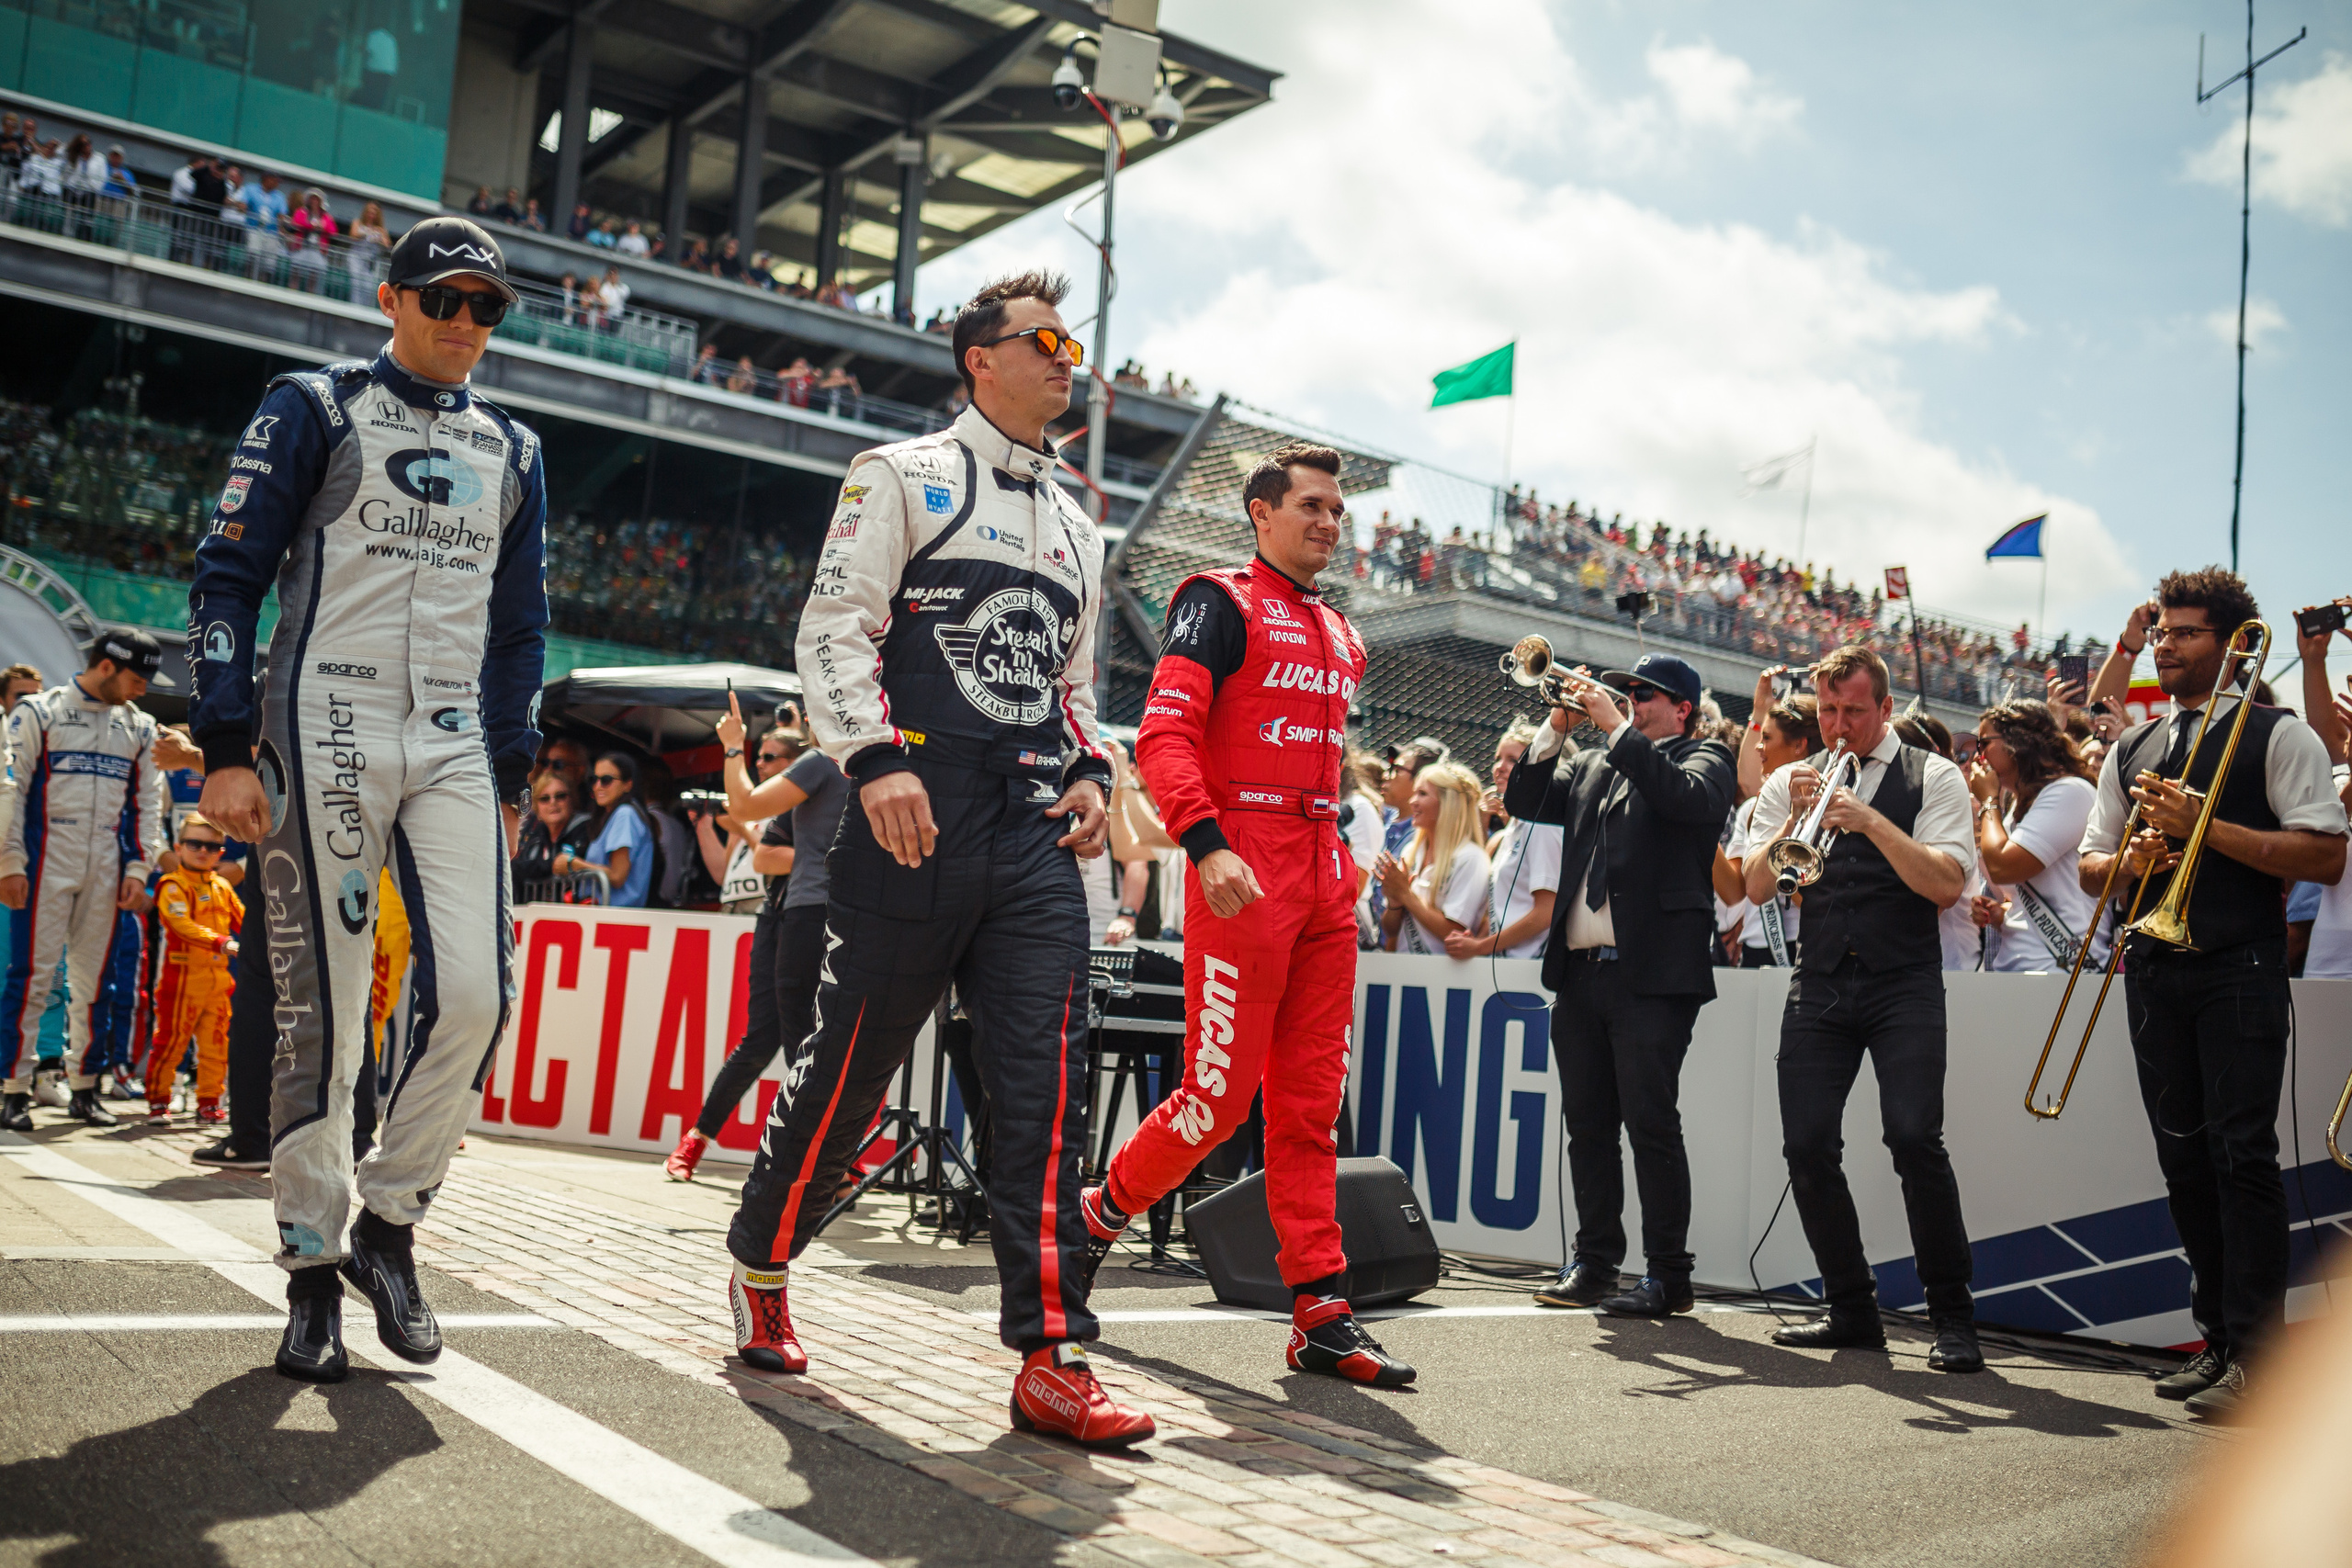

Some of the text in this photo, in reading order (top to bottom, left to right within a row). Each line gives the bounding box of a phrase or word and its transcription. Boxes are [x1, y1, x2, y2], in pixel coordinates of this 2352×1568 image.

[429, 243, 496, 269] MAX
[311, 381, 344, 426] sparco
[370, 419, 419, 434] HONDA
[519, 433, 535, 474] sparco
[236, 456, 272, 474] Cessna
[903, 471, 958, 486] HONDA
[925, 487, 948, 498] WORLD
[928, 503, 952, 513] HYATT
[358, 500, 494, 553] Gallagher
[999, 529, 1023, 544] United
[1000, 536, 1025, 552] Rentals
[986, 594, 1057, 631] FAMOUS FOR
[1261, 616, 1305, 628] HONDA
[1190, 603, 1208, 646] SPYDER
[317, 661, 378, 681] sparco
[1262, 661, 1340, 695] LUCAS
[434, 679, 462, 691] CHILTON
[1159, 688, 1191, 702] oculus
[829, 688, 862, 739] SHAKE
[1145, 705, 1182, 717] pectrum
[1285, 726, 1317, 743] SMP
[1035, 755, 1062, 767] RAHAL
[315, 693, 366, 861] Gallagher
[1238, 790, 1283, 805] sparco
[1765, 902, 1782, 952] PRINCESS
[2035, 913, 2077, 959] PRINCESS
[264, 849, 313, 1072] Gallagher
[372, 953, 390, 1022] DHL
[1167, 953, 1238, 1145] LUCAS OIL
